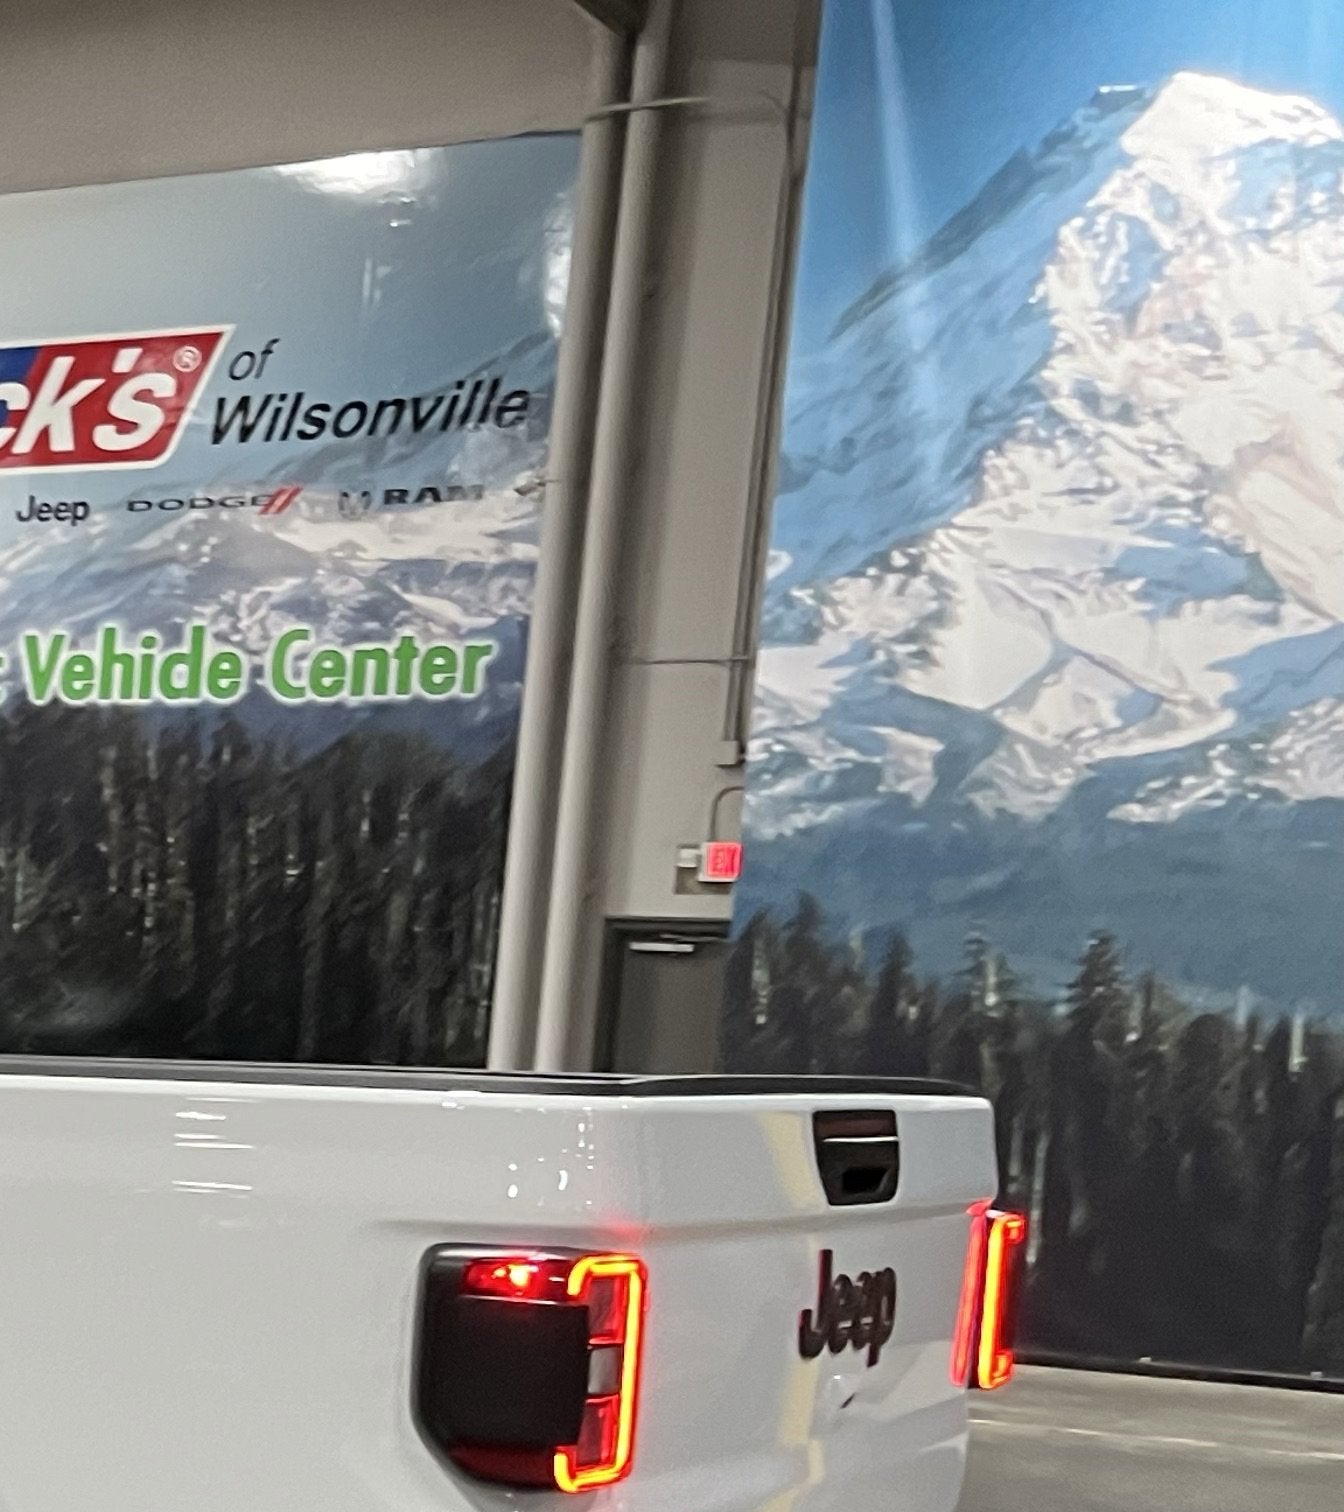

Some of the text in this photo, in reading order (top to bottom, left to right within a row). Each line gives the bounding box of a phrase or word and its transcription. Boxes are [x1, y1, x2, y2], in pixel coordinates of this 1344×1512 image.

[229, 338, 281, 381] of
[211, 376, 530, 445] Wilsonville
[15, 495, 90, 527] Jeep
[126, 493, 274, 512] DODGE
[382, 483, 485, 506] RAM
[22, 624, 243, 702] Vehicle
[269, 627, 494, 700] Center
[798, 1247, 897, 1369] Jeep
